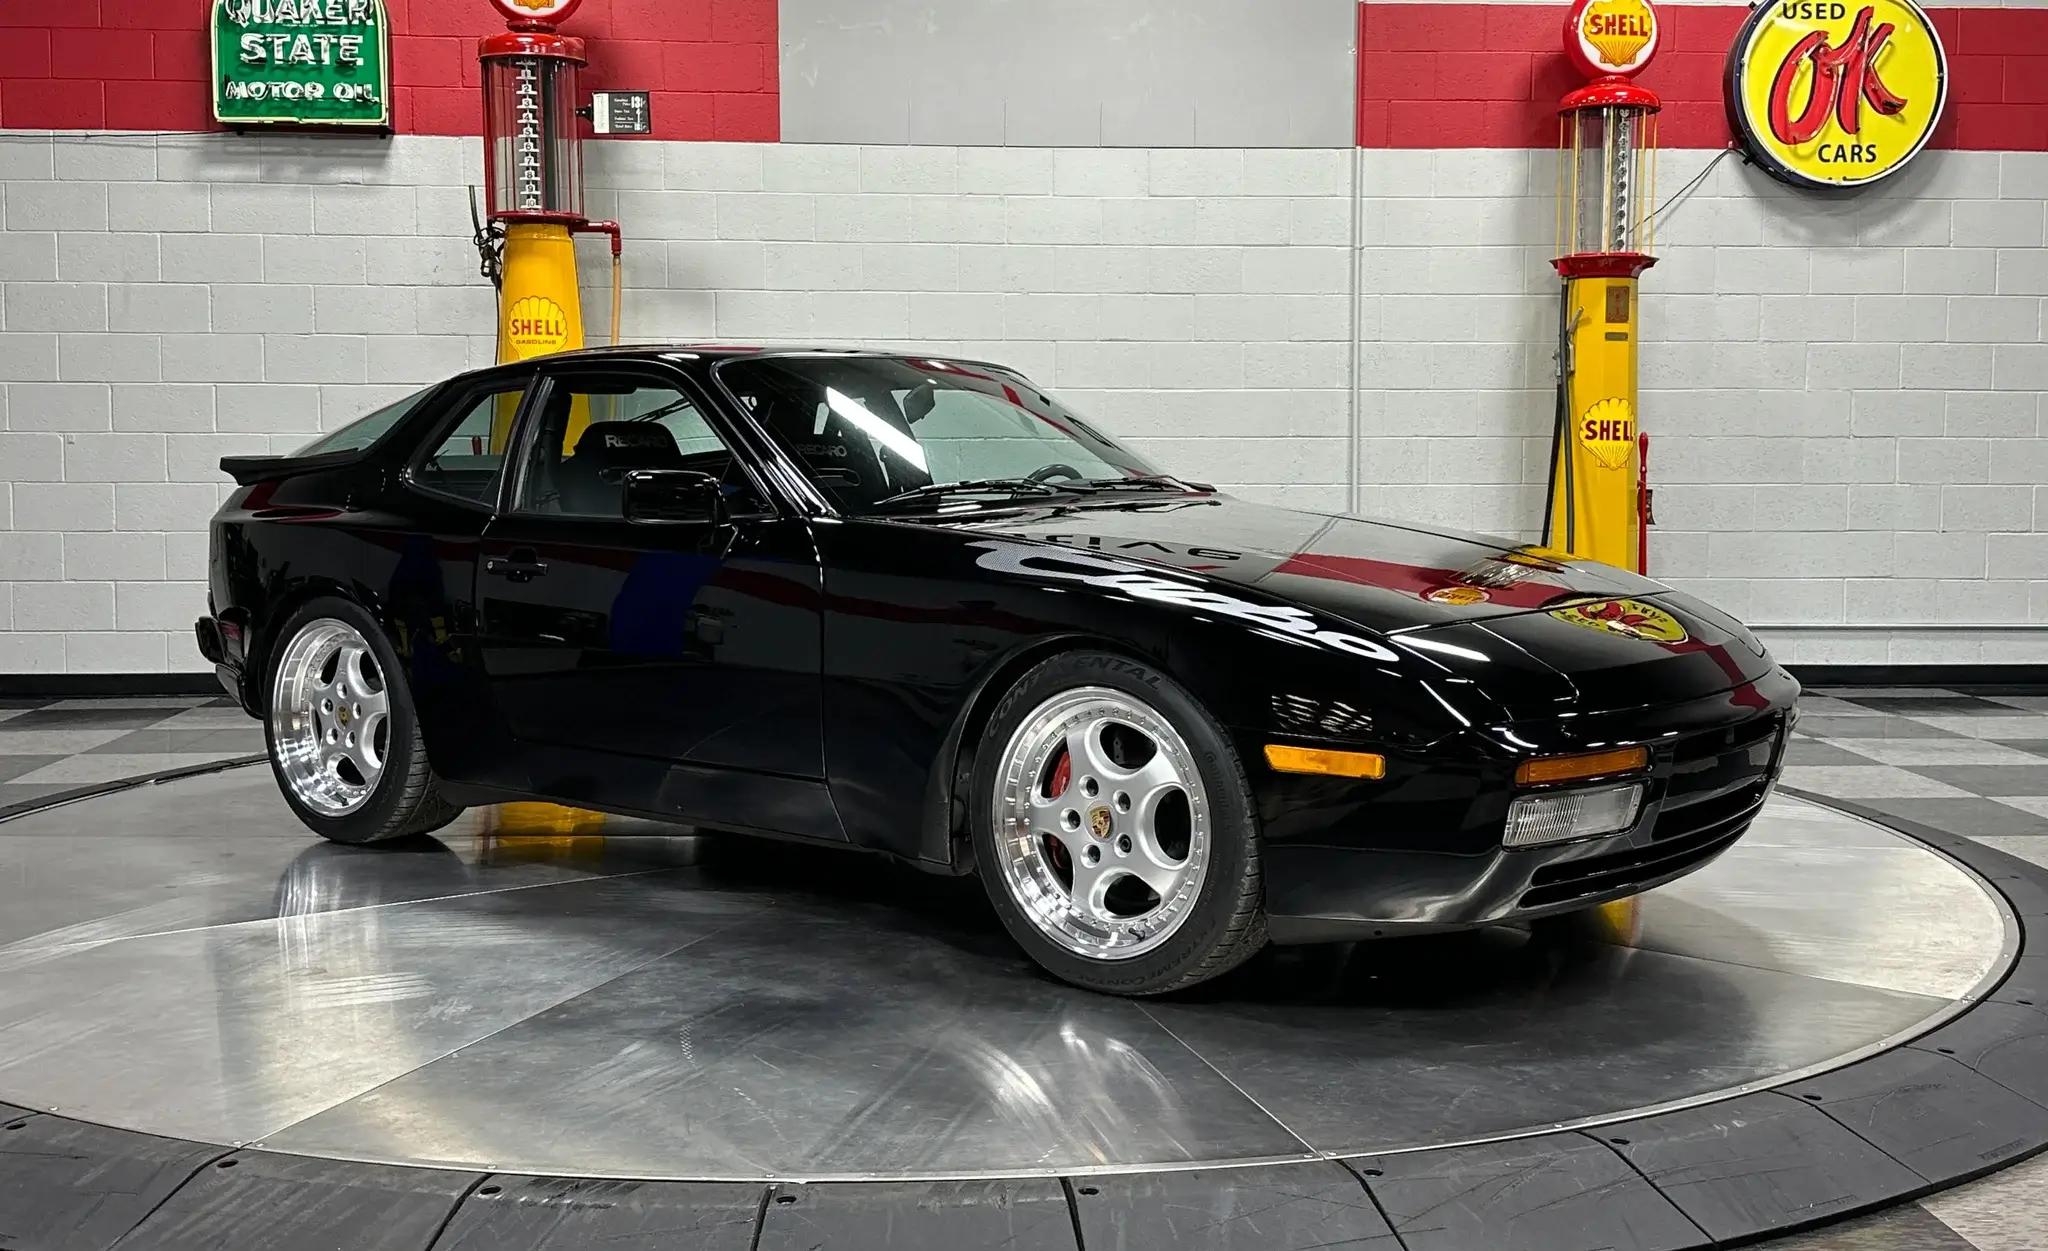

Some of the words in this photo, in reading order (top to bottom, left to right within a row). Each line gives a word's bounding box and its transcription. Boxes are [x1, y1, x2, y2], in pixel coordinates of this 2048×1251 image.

[225, 0, 375, 28] QUAKER
[1782, 3, 1846, 20] USED
[1590, 14, 1648, 37] SHELL
[240, 33, 364, 66] STATE
[1768, 5, 1908, 145] OK
[226, 81, 325, 101] MOTOR
[333, 83, 380, 103] OIL
[1818, 144, 1877, 163] CARS
[512, 319, 562, 336] SHELL
[1585, 420, 1633, 441] SHELL
